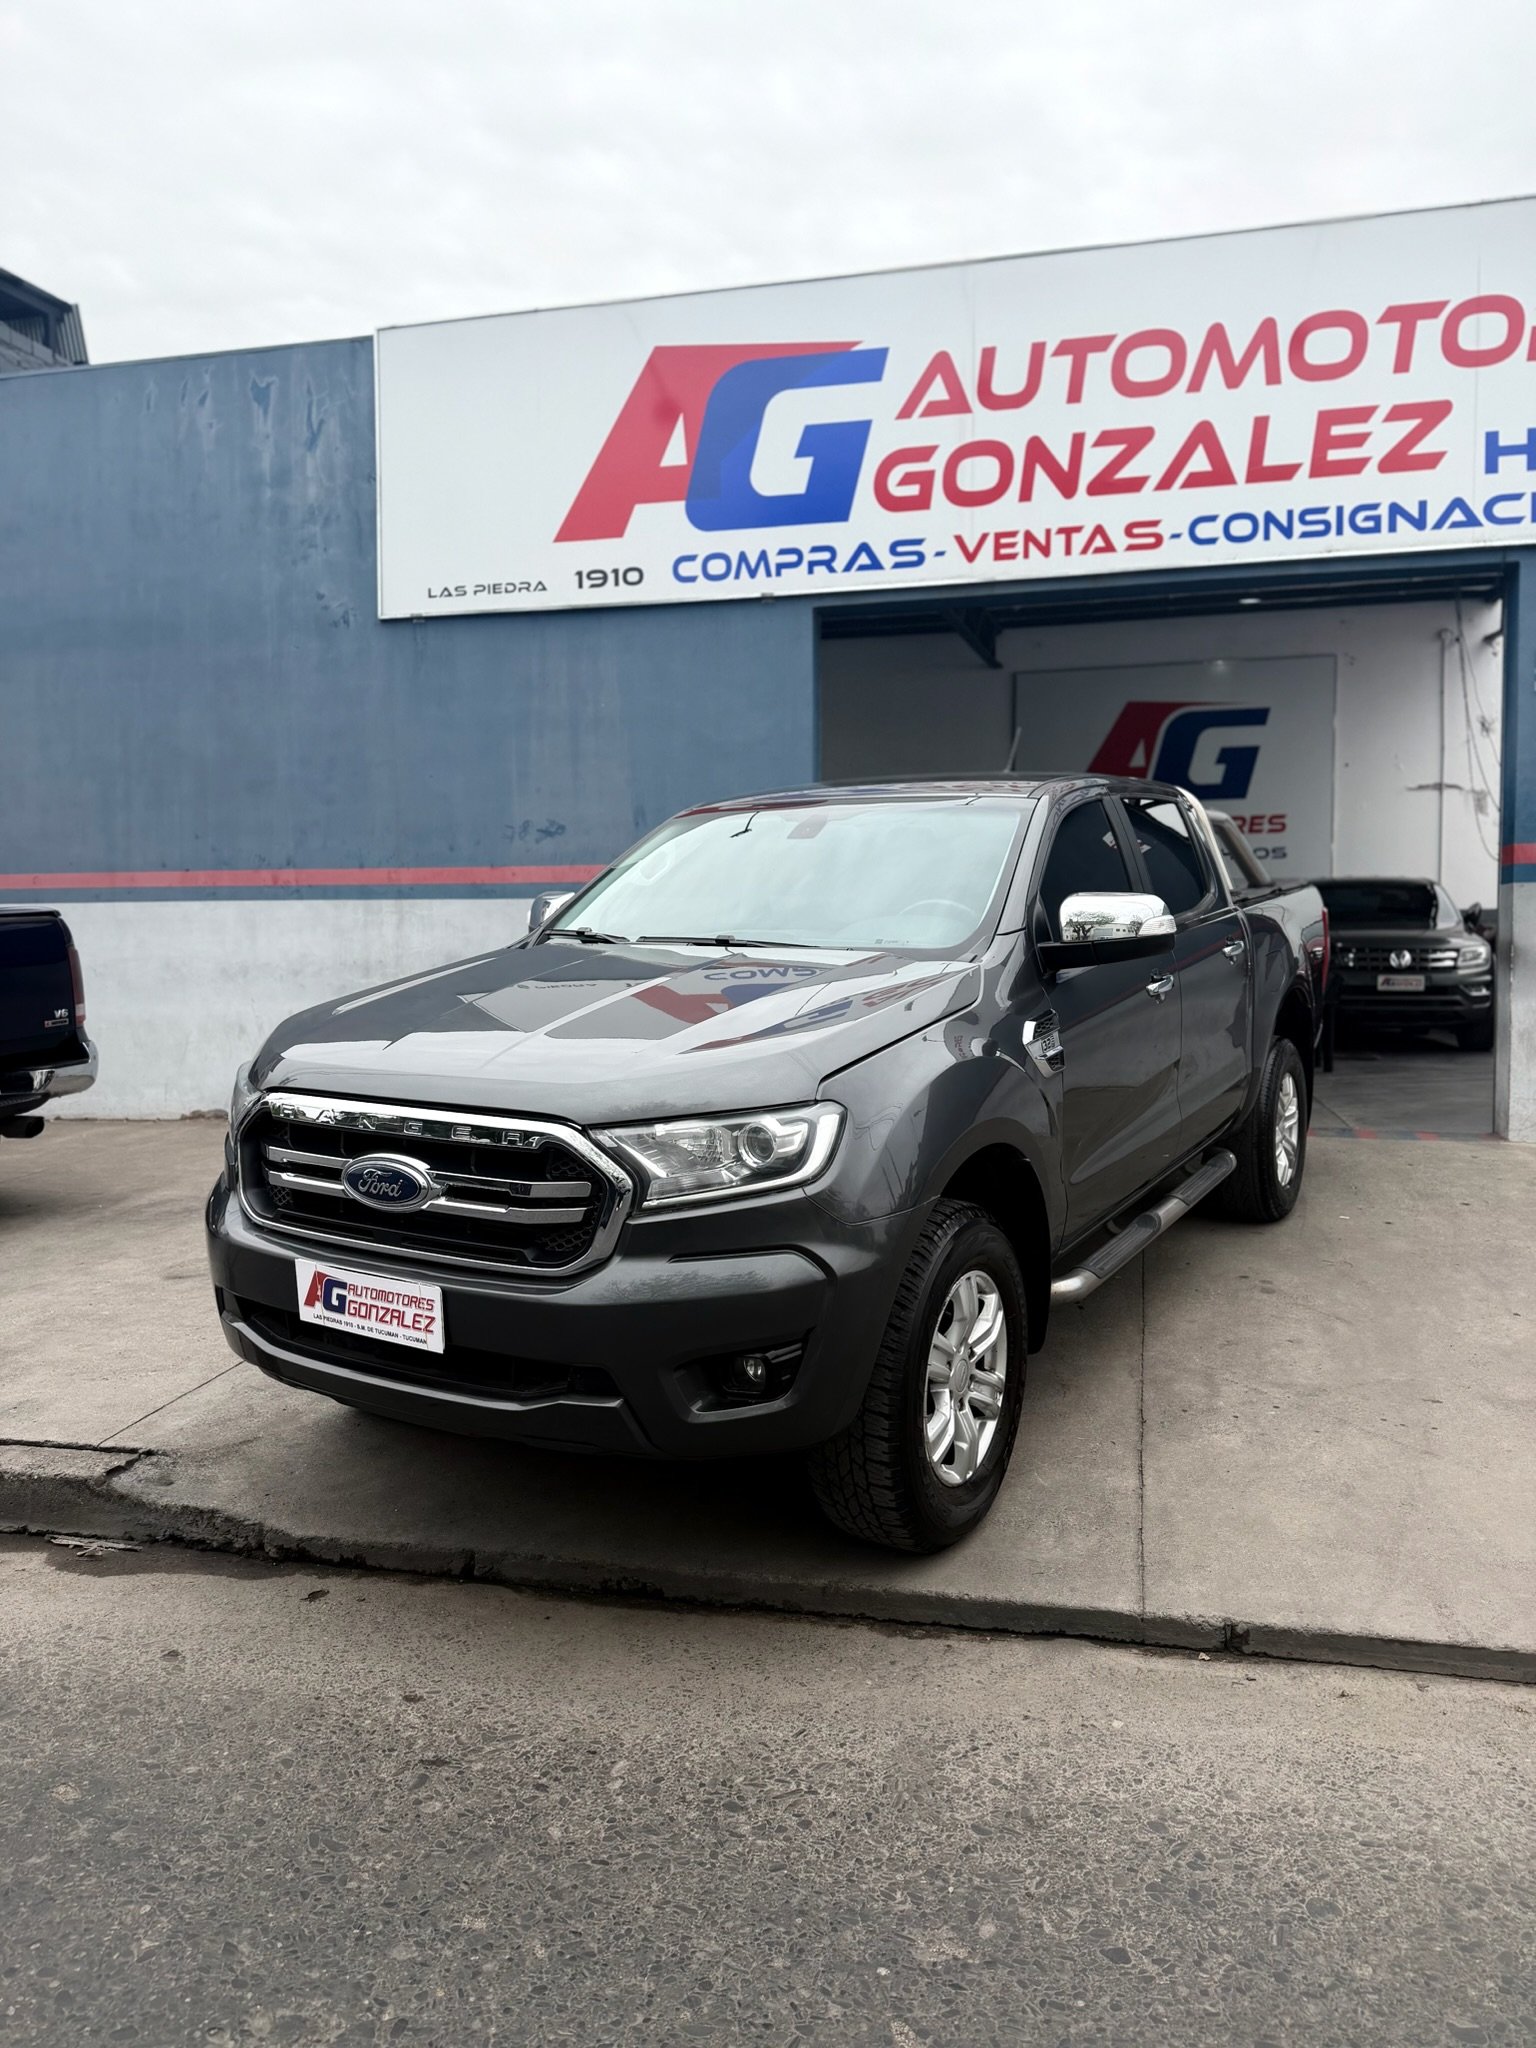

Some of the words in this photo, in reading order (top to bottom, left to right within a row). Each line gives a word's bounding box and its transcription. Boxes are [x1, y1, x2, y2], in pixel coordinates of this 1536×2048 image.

[895, 295, 1536, 421] AUTOMOTO
[553, 341, 890, 544] AG
[873, 399, 1454, 513] GONZALEZ
[427, 585, 468, 599] LAS
[473, 580, 548, 596] PIEDRA
[575, 566, 644, 590] 1910
[279, 1103, 525, 1146] RANGER
[357, 1168, 404, 1198] Ford
[303, 1269, 349, 1316] AG
[347, 1283, 436, 1311] AUTOMOTORES
[313, 1312, 323, 1320] LAS
[347, 1299, 437, 1334] GONZALEZ
